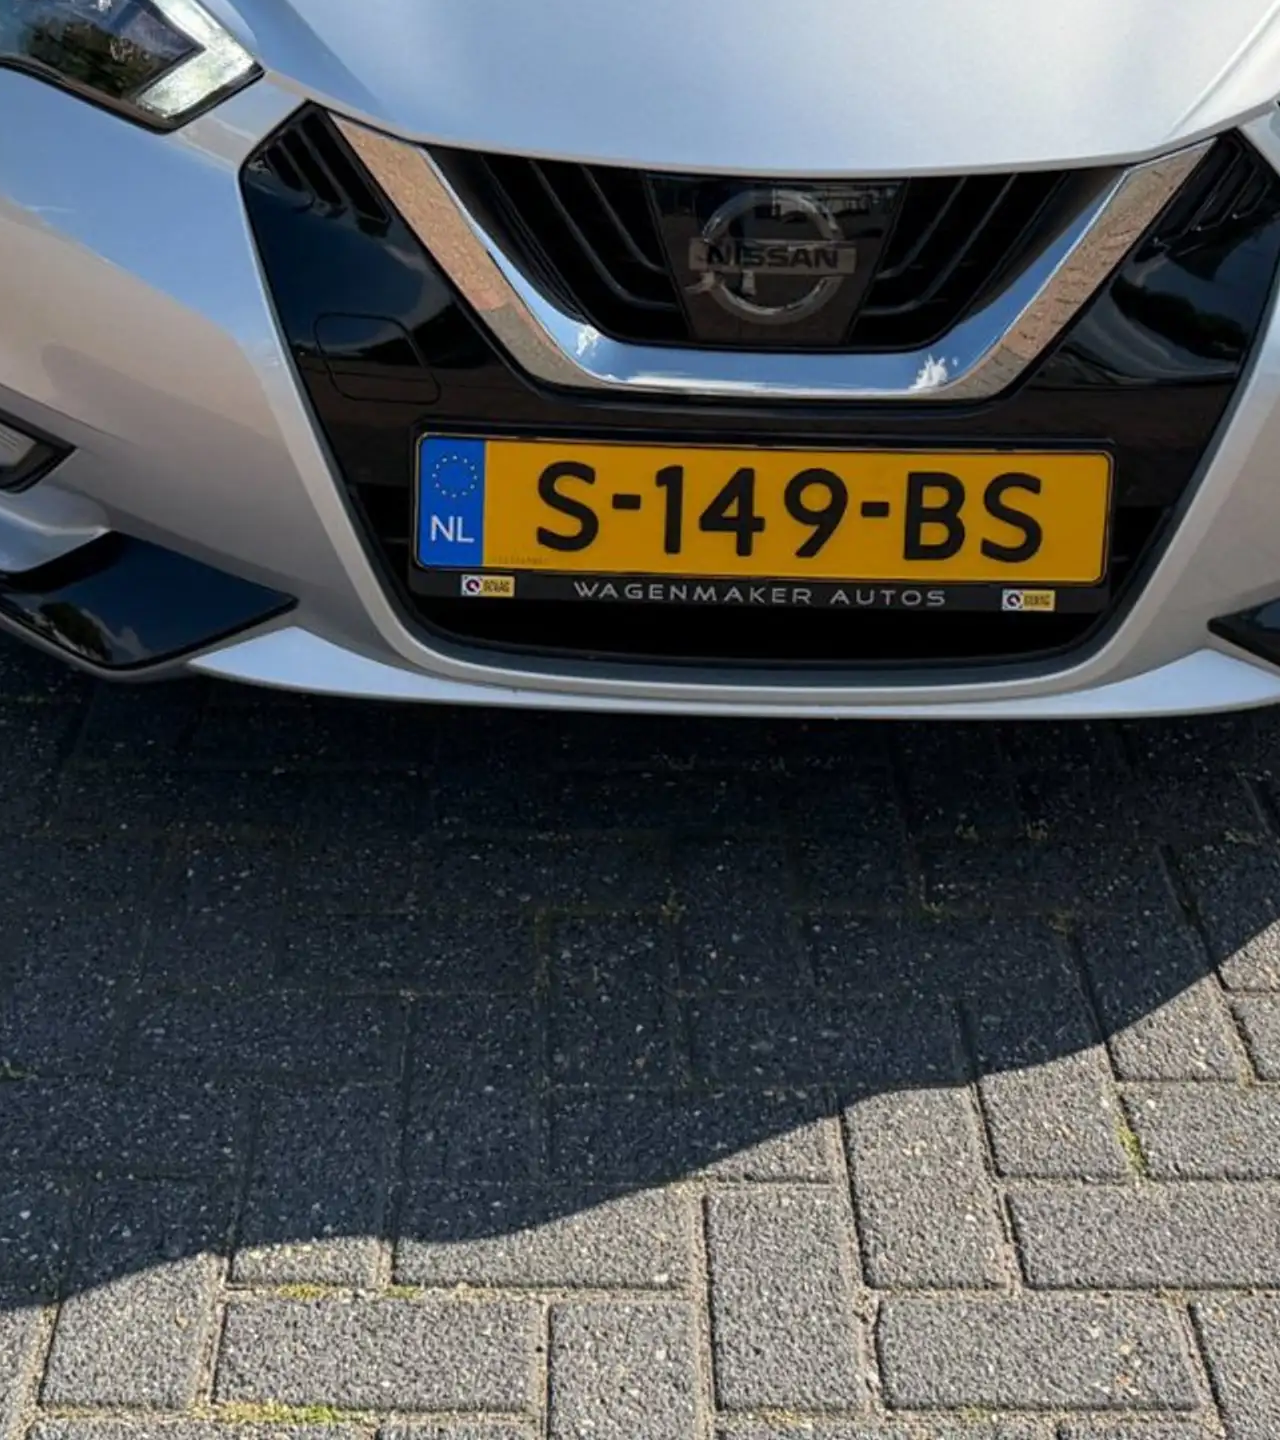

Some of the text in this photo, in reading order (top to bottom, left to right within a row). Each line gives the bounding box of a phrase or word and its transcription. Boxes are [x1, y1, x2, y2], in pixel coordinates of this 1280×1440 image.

[707, 243, 839, 269] NISSAN
[535, 460, 1043, 563] S-149-BS
[429, 514, 475, 544] NL
[573, 580, 947, 608] WAGENMAKER AUTOS
